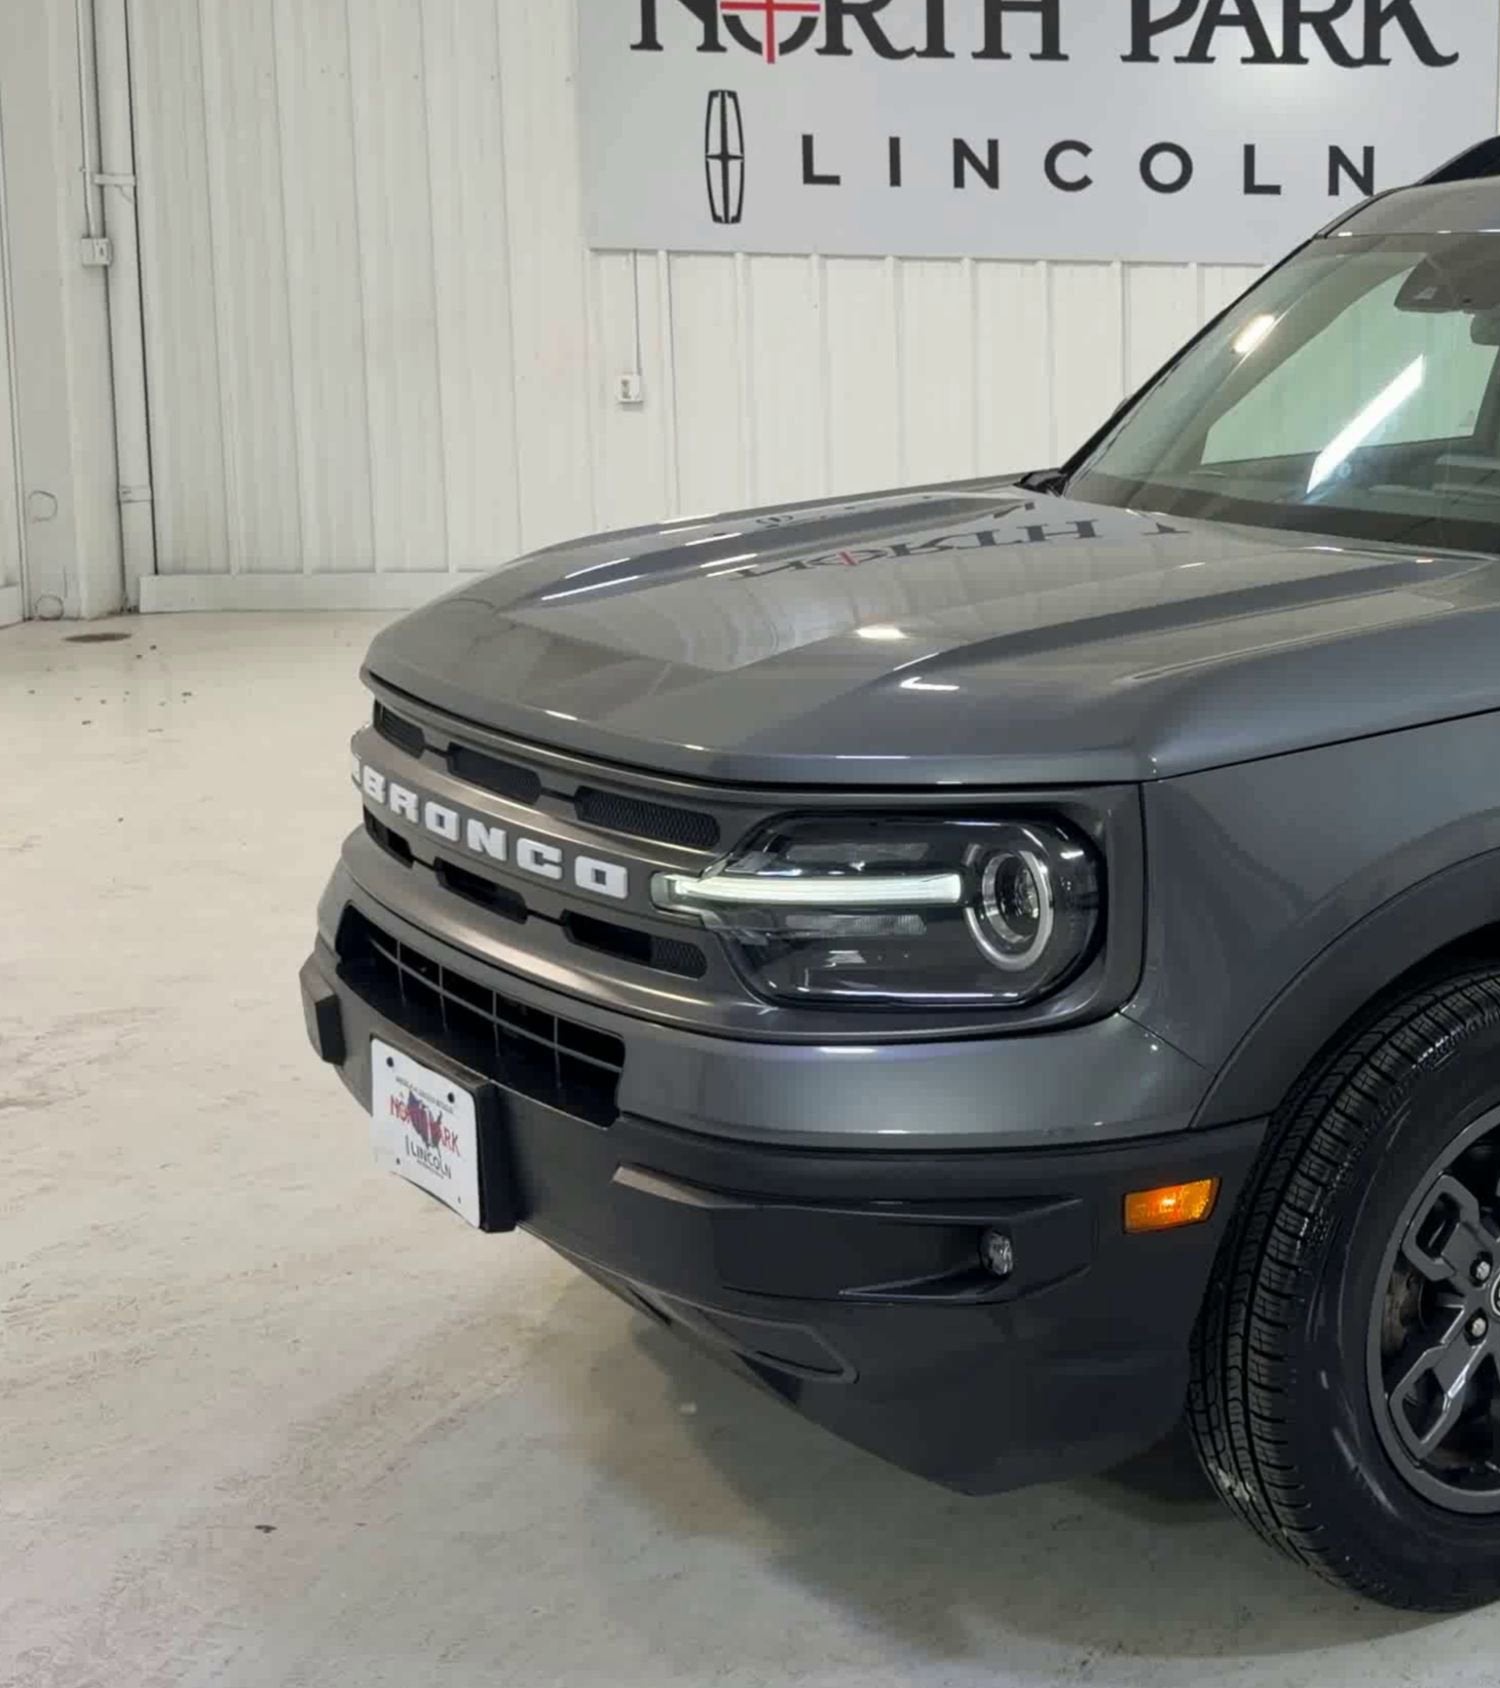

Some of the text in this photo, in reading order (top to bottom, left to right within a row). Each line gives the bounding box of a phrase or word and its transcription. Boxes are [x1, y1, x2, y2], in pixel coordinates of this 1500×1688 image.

[801, 134, 1375, 197] LINCOLN
[363, 765, 628, 899] BRONCO
[411, 1141, 452, 1179] LINCOLN
